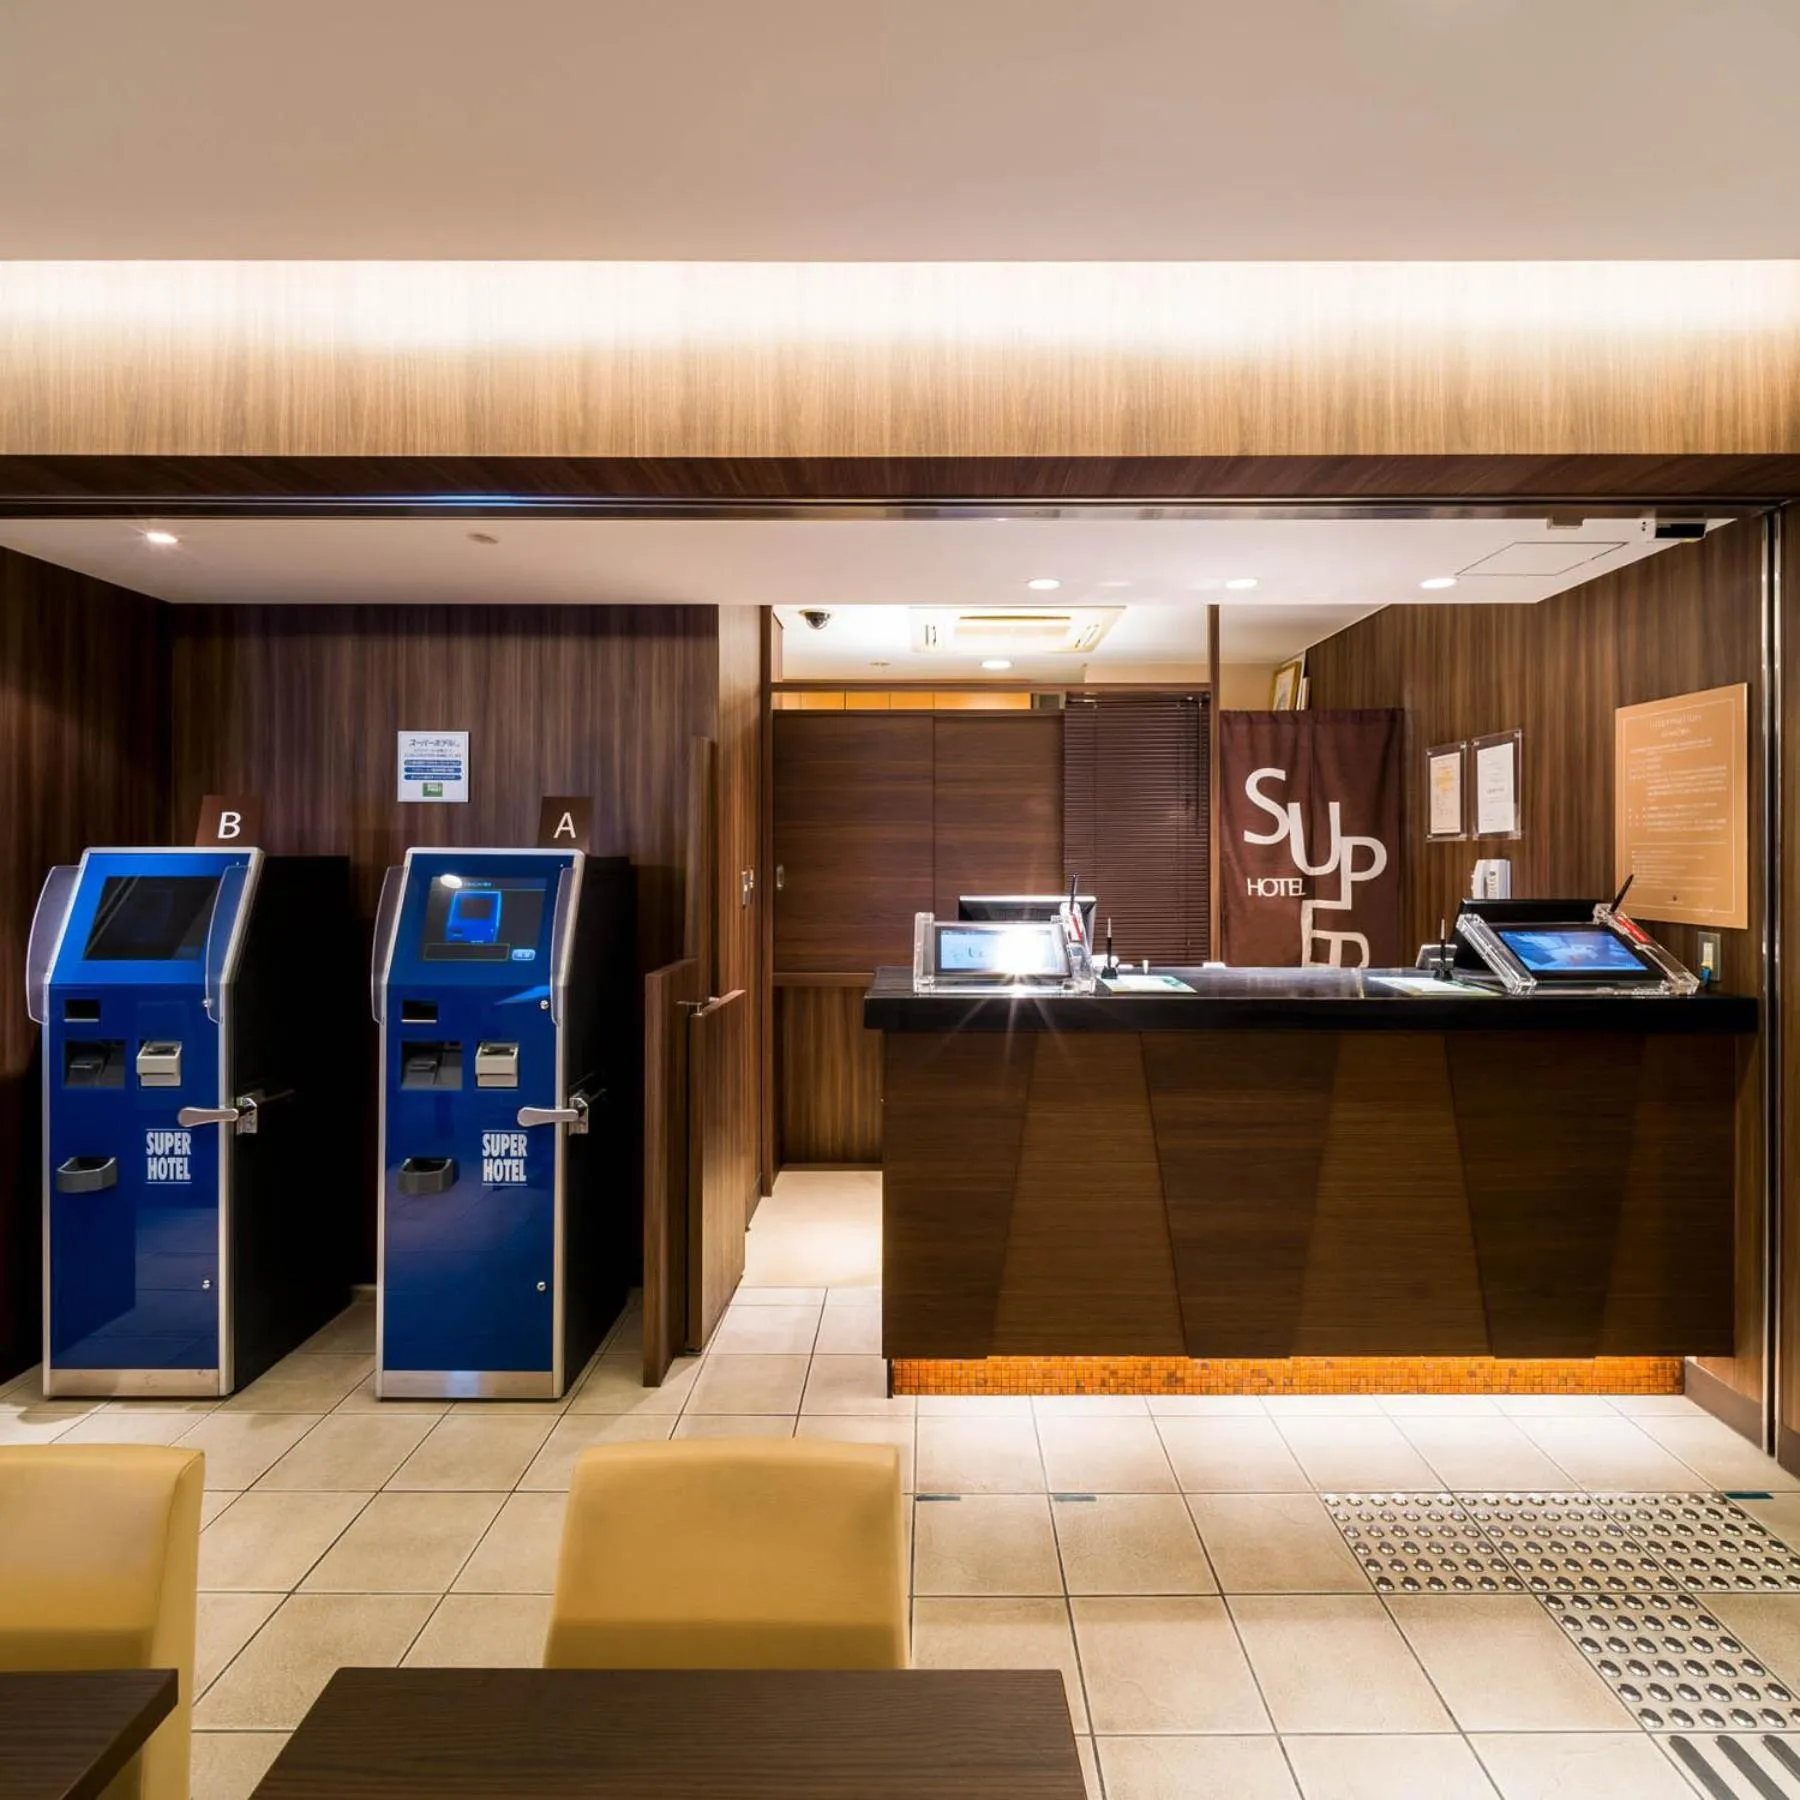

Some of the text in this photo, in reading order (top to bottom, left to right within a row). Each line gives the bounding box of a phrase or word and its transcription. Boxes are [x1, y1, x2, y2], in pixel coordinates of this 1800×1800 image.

[218, 811, 241, 839] B
[553, 811, 576, 839] A
[1247, 877, 1307, 897] HOTEL
[145, 1131, 192, 1156] SUPER
[482, 1133, 528, 1157] SUPER
[147, 1157, 192, 1180] HOTEL
[483, 1158, 527, 1182] HOTEL
